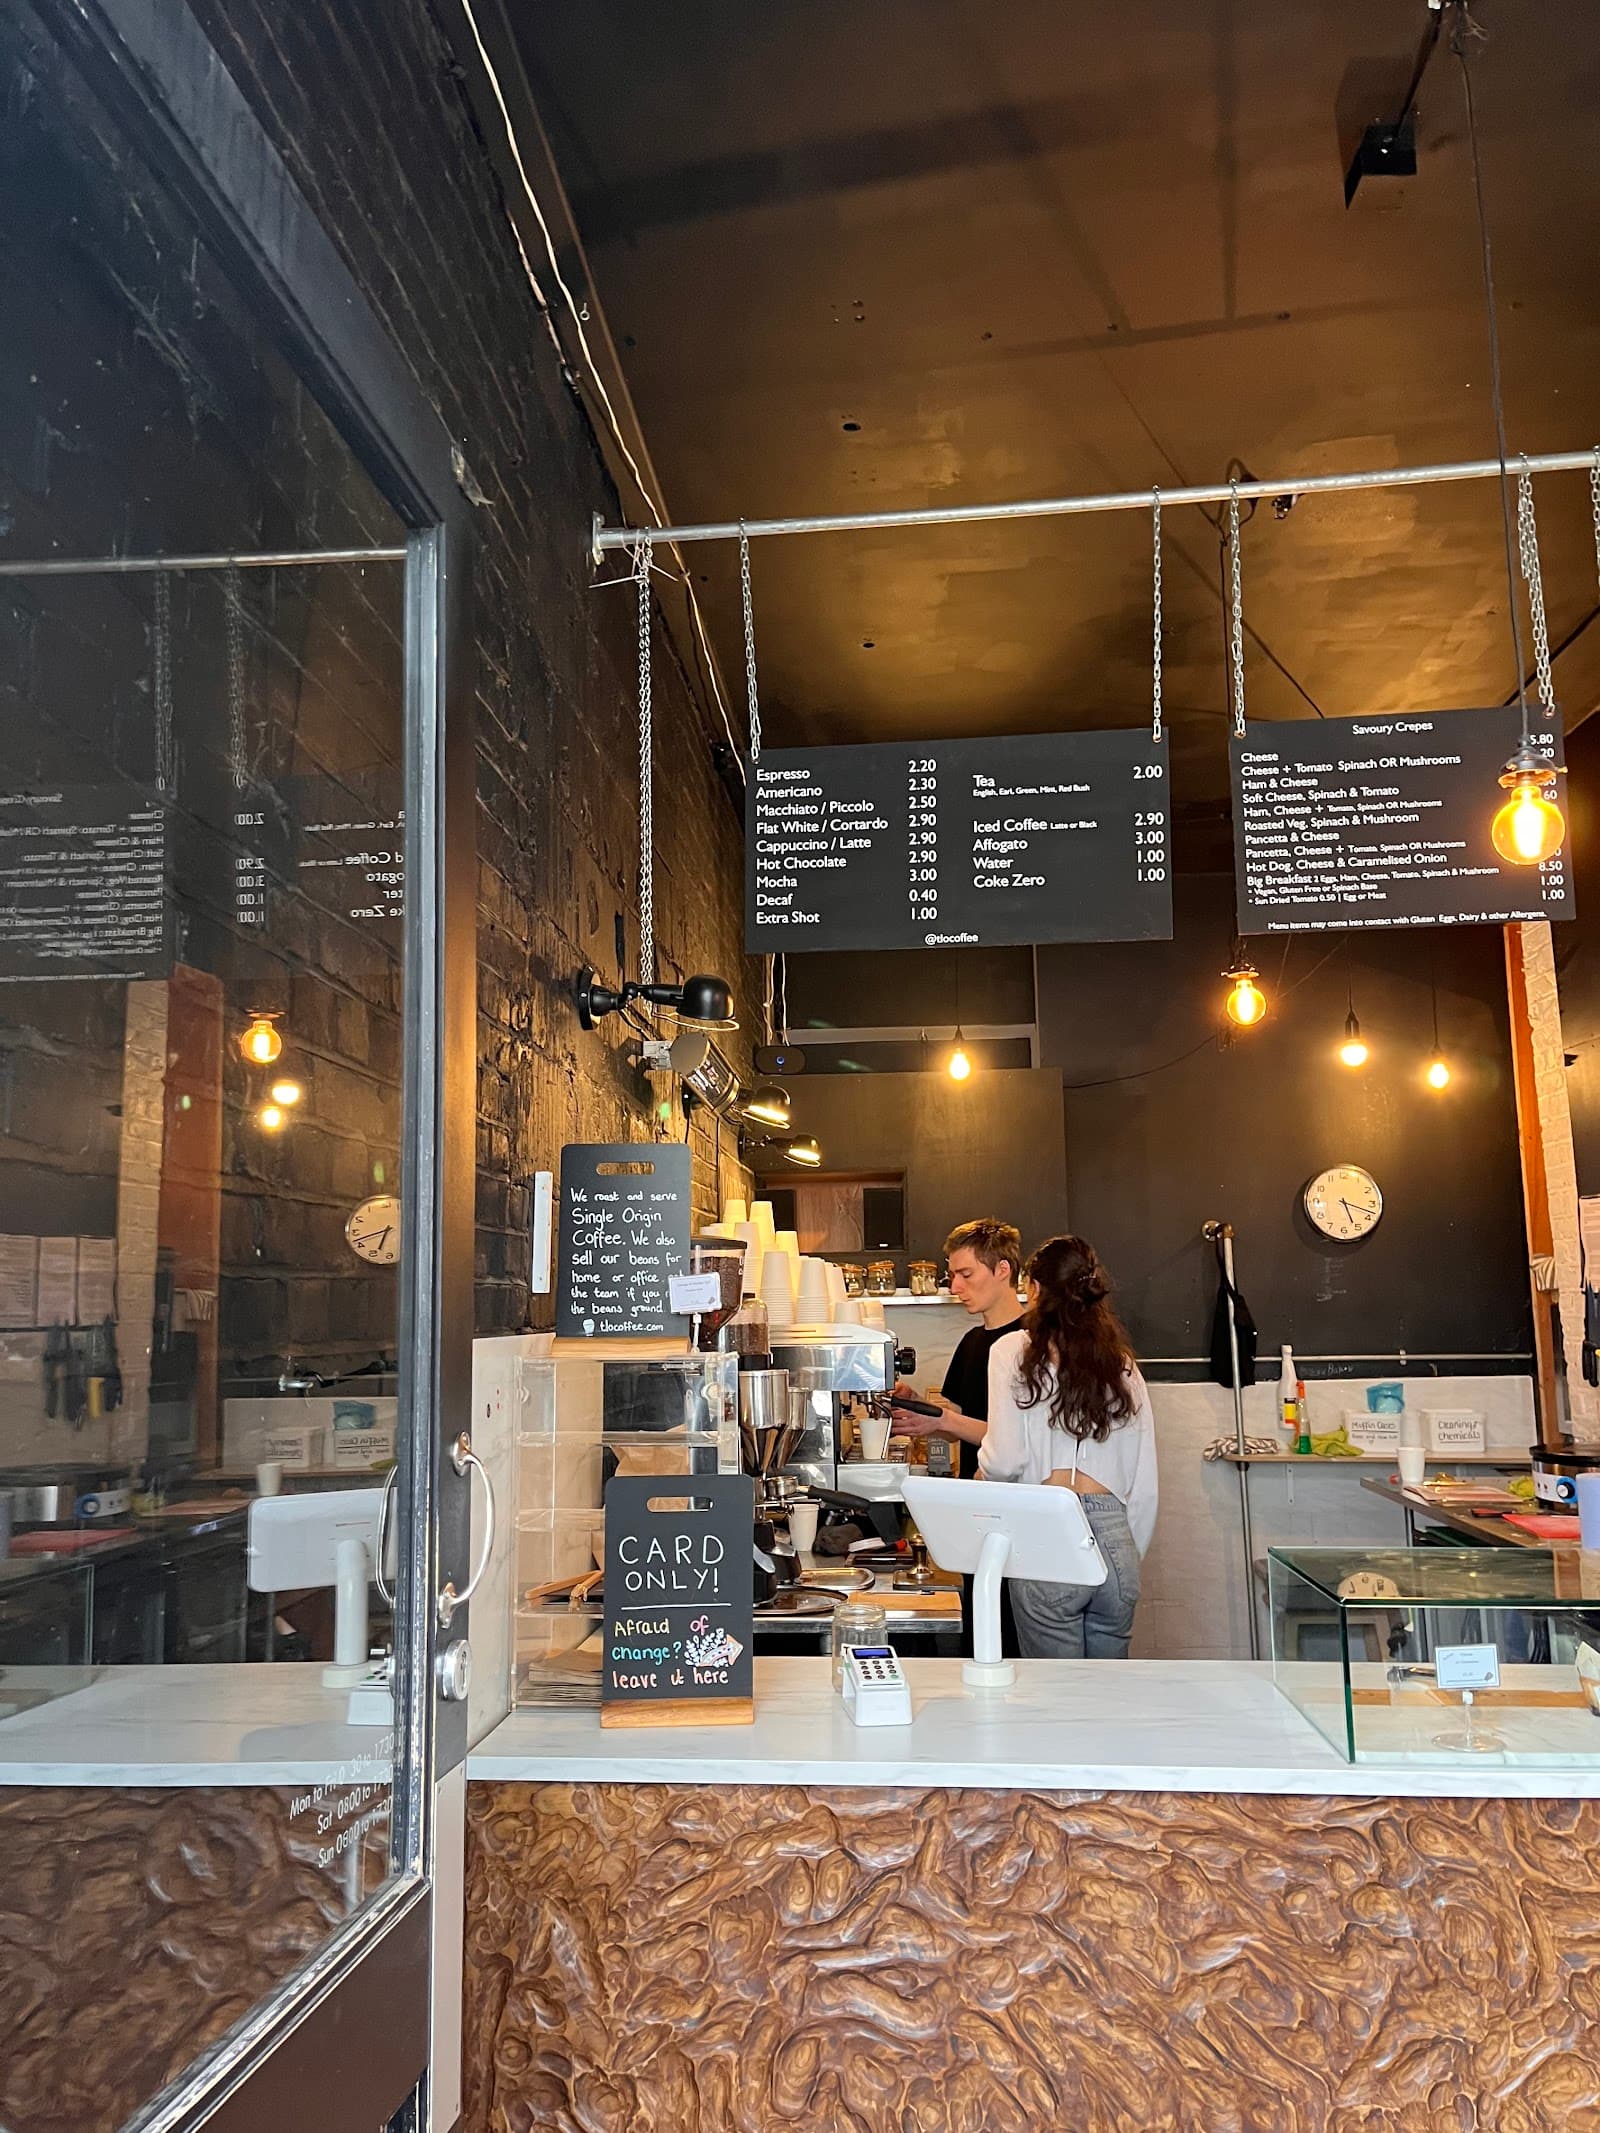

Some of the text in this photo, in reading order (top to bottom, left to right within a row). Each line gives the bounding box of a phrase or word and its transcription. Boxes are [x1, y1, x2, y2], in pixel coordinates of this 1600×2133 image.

[1353, 722, 1433, 734] Savoury Crepes
[1241, 753, 1278, 762] Cheese
[909, 759, 936, 772] 2.20
[1134, 765, 1162, 778] 2.00
[1242, 756, 1460, 776] Cheese Tomato Spinach OR Mushrooms
[757, 769, 810, 782] Espresso
[973, 775, 995, 787] Tea
[909, 778, 936, 790] 2.30
[1243, 778, 1318, 789] Ham & Cheese
[756, 786, 822, 798] Americano
[1243, 793, 1263, 803] Soft
[1308, 788, 1347, 802] Spinach
[1350, 788, 1358, 797] &
[1360, 787, 1399, 796] Tomato
[757, 800, 874, 816] Macchiato Piccolo
[909, 796, 936, 809] 2.50
[1274, 806, 1311, 815] Cheese
[757, 817, 888, 834] Flat White Cortardo
[909, 814, 936, 827] 2.90
[974, 818, 1047, 832] Iced Coffee
[1135, 812, 1164, 826] 2.90
[1245, 820, 1284, 830] Roasted
[1311, 816, 1349, 829] Spinach
[1352, 815, 1360, 825] &
[1363, 814, 1419, 824] Mushroom
[909, 832, 936, 845] 2.90
[1136, 831, 1164, 844] 3.00
[1246, 832, 1339, 844] Pancetta & Cheese
[756, 837, 871, 854] Cappuccino Latte
[973, 838, 1028, 853] Affogato
[1246, 846, 1332, 858] Pancetta, Cheese
[909, 850, 936, 863] 2.90
[1138, 850, 1164, 862] 1.00
[757, 856, 846, 870] Hot Chocolate
[973, 857, 1014, 869] Water
[1247, 863, 1266, 872] Hot
[1296, 860, 1334, 869] Cheese
[1337, 858, 1345, 867] &
[1348, 854, 1411, 866] Caramelised
[1414, 854, 1446, 863] Onion
[1538, 862, 1562, 871] 8.50
[910, 868, 937, 881] 3.00
[974, 874, 1045, 888] Coke Zero
[1138, 868, 1165, 881] 1.00
[1247, 875, 1312, 887] Big Breakfast
[1541, 876, 1563, 885] 1.00
[757, 876, 797, 888] Mocha
[757, 893, 793, 906] Decaf
[909, 889, 937, 901] 0.40
[1542, 890, 1565, 900] 1.00
[757, 911, 820, 924] Extra Shot
[912, 907, 937, 920] 1.00
[925, 933, 978, 945] @tlocoffee
[571, 1188, 678, 1202] We roast and serve
[572, 1208, 662, 1231] Single Origin
[573, 1230, 675, 1248] Coffee. We also
[572, 1250, 682, 1266] sell our beans for
[572, 1270, 600, 1283] home
[612, 1274, 624, 1282] or
[571, 1286, 588, 1298] the
[594, 1288, 619, 1298] team
[626, 1287, 635, 1301] if
[642, 1292, 660, 1302] you
[571, 1301, 584, 1314] the
[592, 1303, 622, 1314] beans
[600, 1320, 663, 1332] tlocoffee.com
[931, 1447, 944, 1455] OAT
[619, 1535, 723, 1564] CARD
[626, 1568, 718, 1592] ONLY!
[615, 1615, 710, 1636] Afraid of
[612, 1642, 681, 1665] change?
[613, 1667, 729, 1688] leave it here
[290, 1787, 322, 1820] Mon to
[317, 1785, 370, 1834] Sat 0800 to
